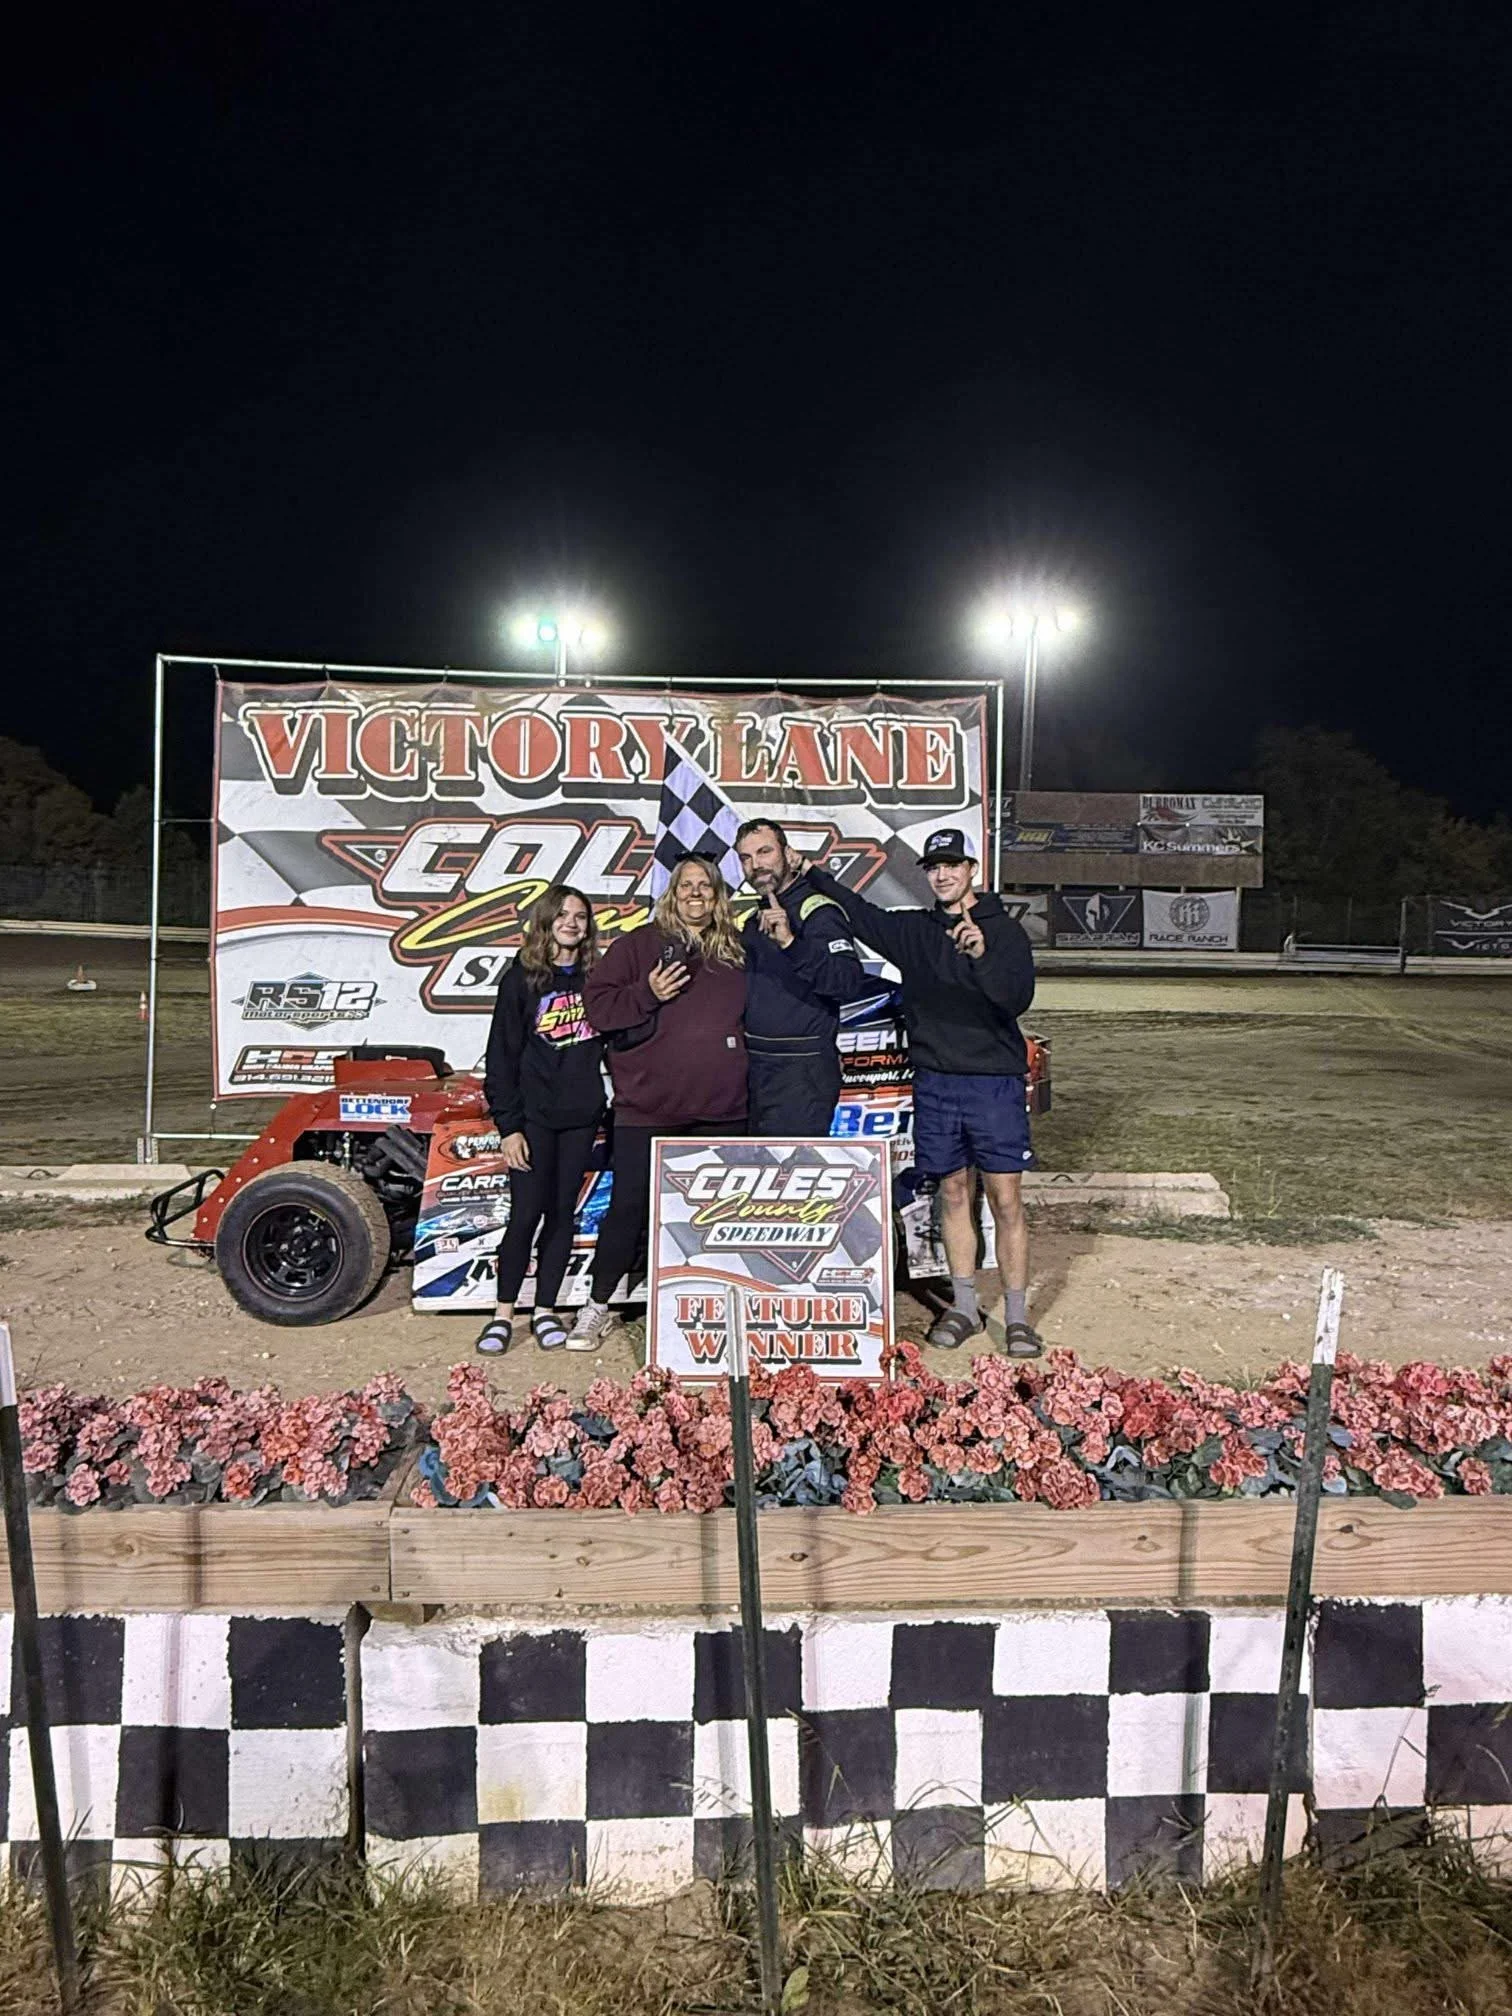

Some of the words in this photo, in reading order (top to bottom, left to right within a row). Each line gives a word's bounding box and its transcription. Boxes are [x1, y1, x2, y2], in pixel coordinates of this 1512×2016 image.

[242, 703, 699, 798] VICTORY
[711, 711, 966, 806] LANE
[1167, 842, 1240, 853] Summers
[1150, 933, 1183, 943] RACE
[1187, 934, 1228, 944] RANCH
[247, 981, 376, 1011] RS12
[342, 1104, 409, 1115] LOCK
[687, 1167, 853, 1200] COLES
[695, 1192, 844, 1225] County
[714, 1226, 834, 1243] SPEEDWAY
[676, 1294, 865, 1326] FETURE
[685, 1329, 857, 1360] WNNER
